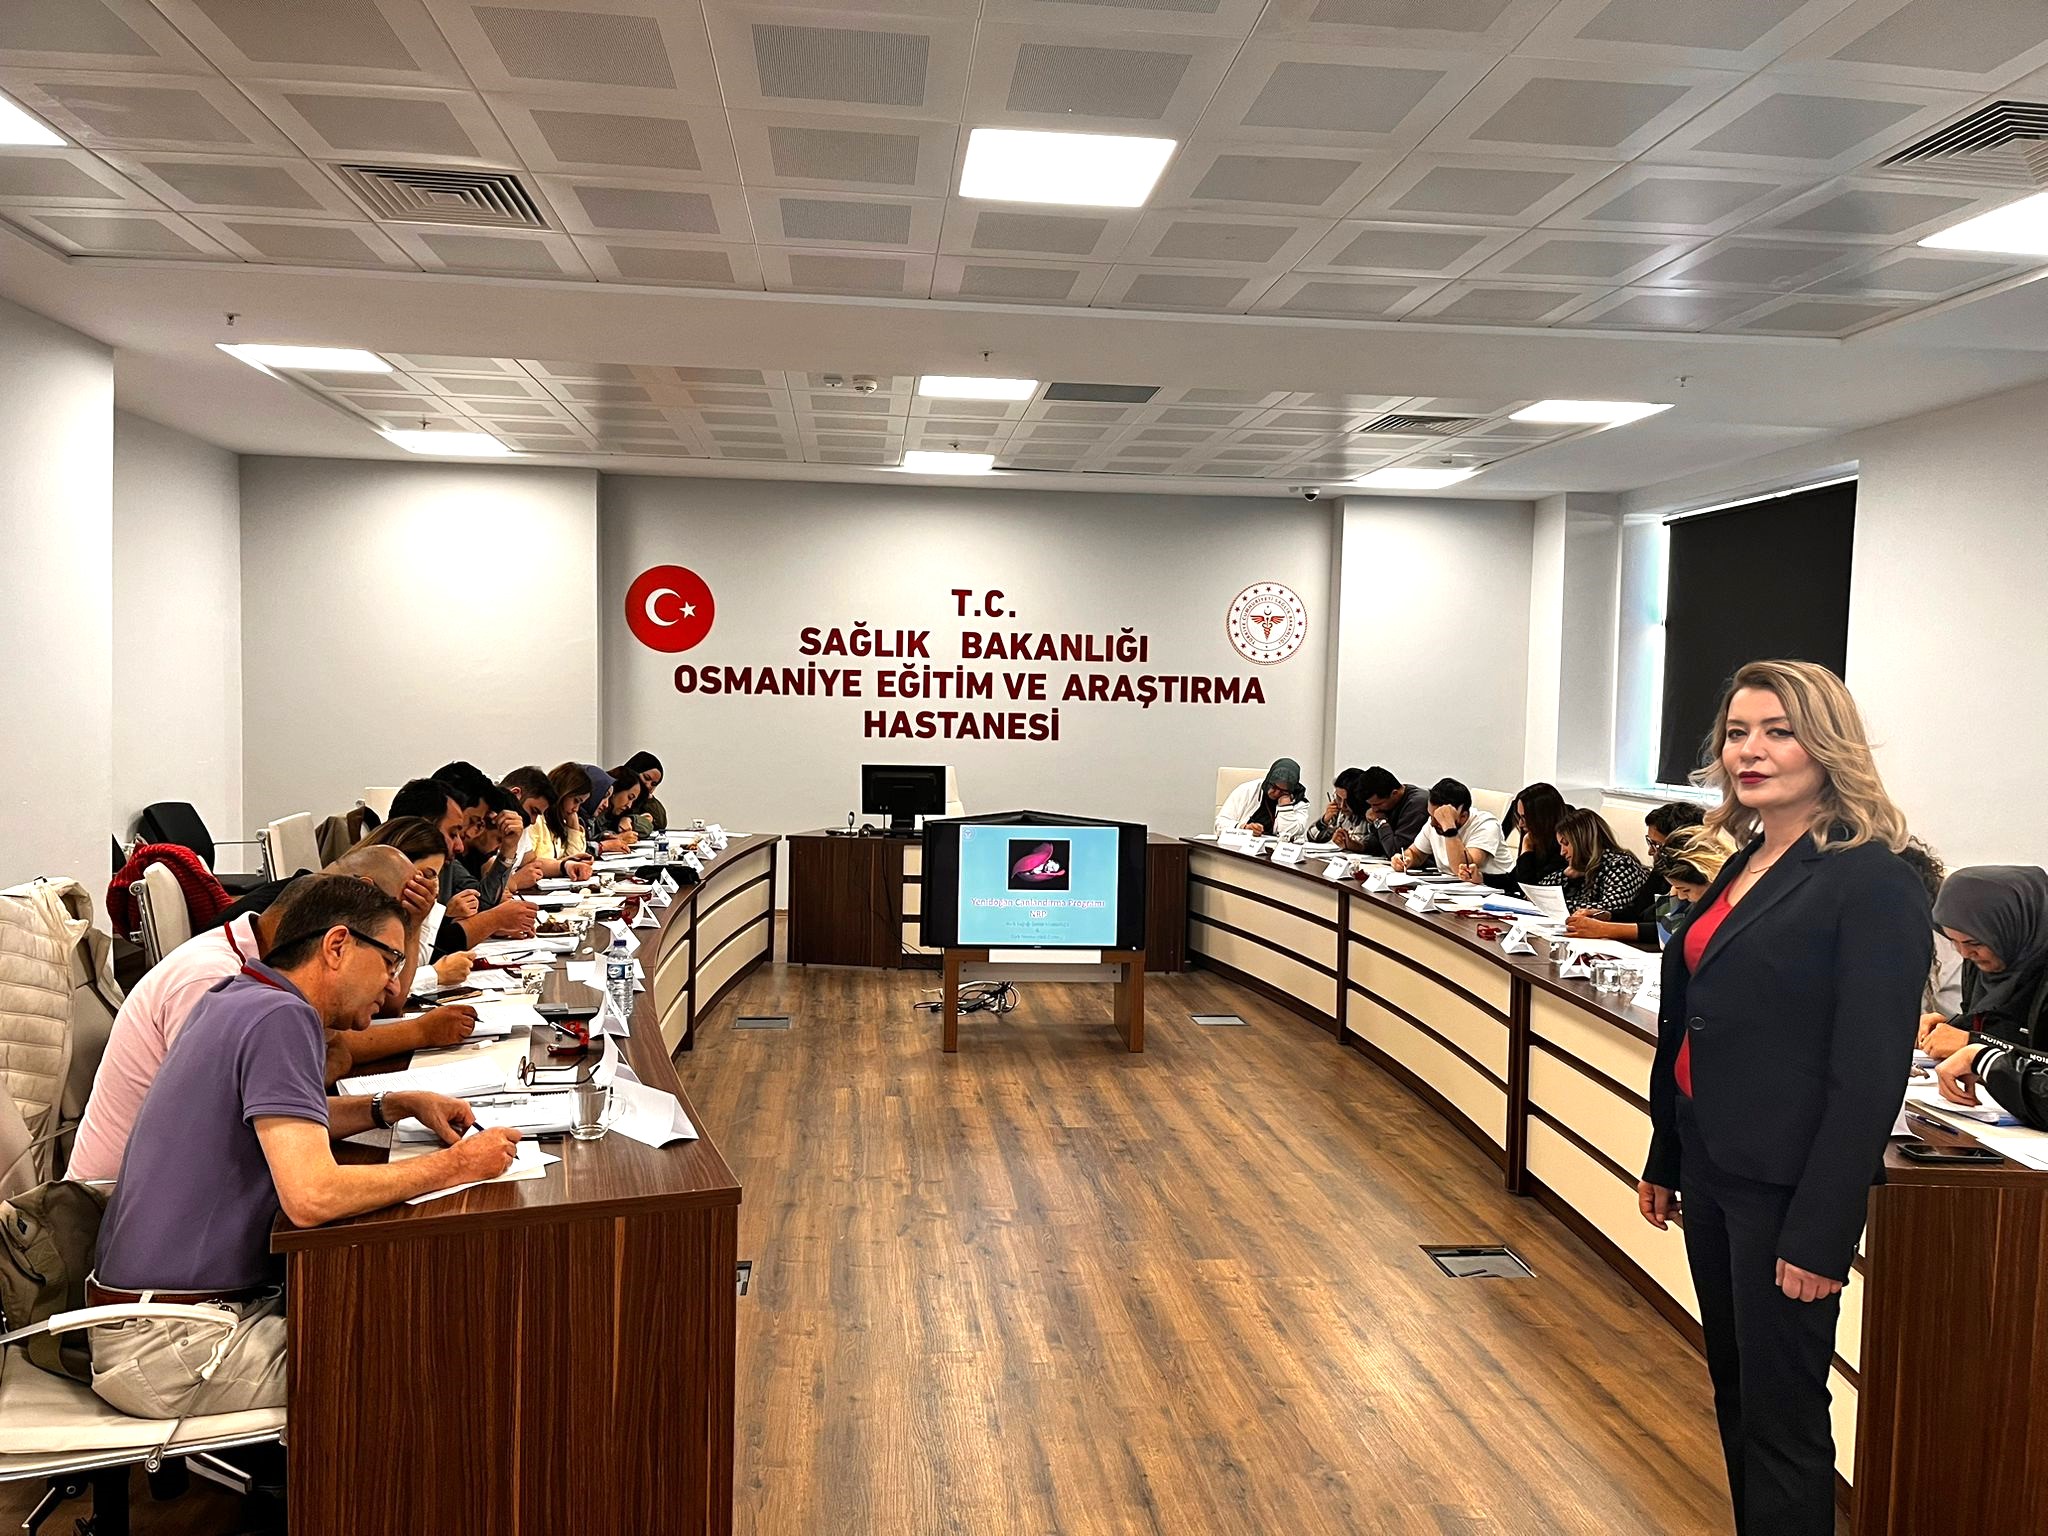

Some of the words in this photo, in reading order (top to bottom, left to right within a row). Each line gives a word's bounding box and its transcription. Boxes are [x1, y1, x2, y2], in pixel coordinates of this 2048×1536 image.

[952, 589, 1016, 617] T.C.
[799, 621, 930, 658] SAĞLIK
[961, 627, 1147, 662] BAKANLIĞI
[674, 662, 861, 697] OSMANİYE
[877, 663, 992, 699] EĞİTİM
[1003, 673, 1046, 700] VE
[1062, 674, 1265, 708] ARAŞTIRMA
[864, 708, 1059, 740] HASTANESİ
[1029, 910, 1047, 918] NRP
